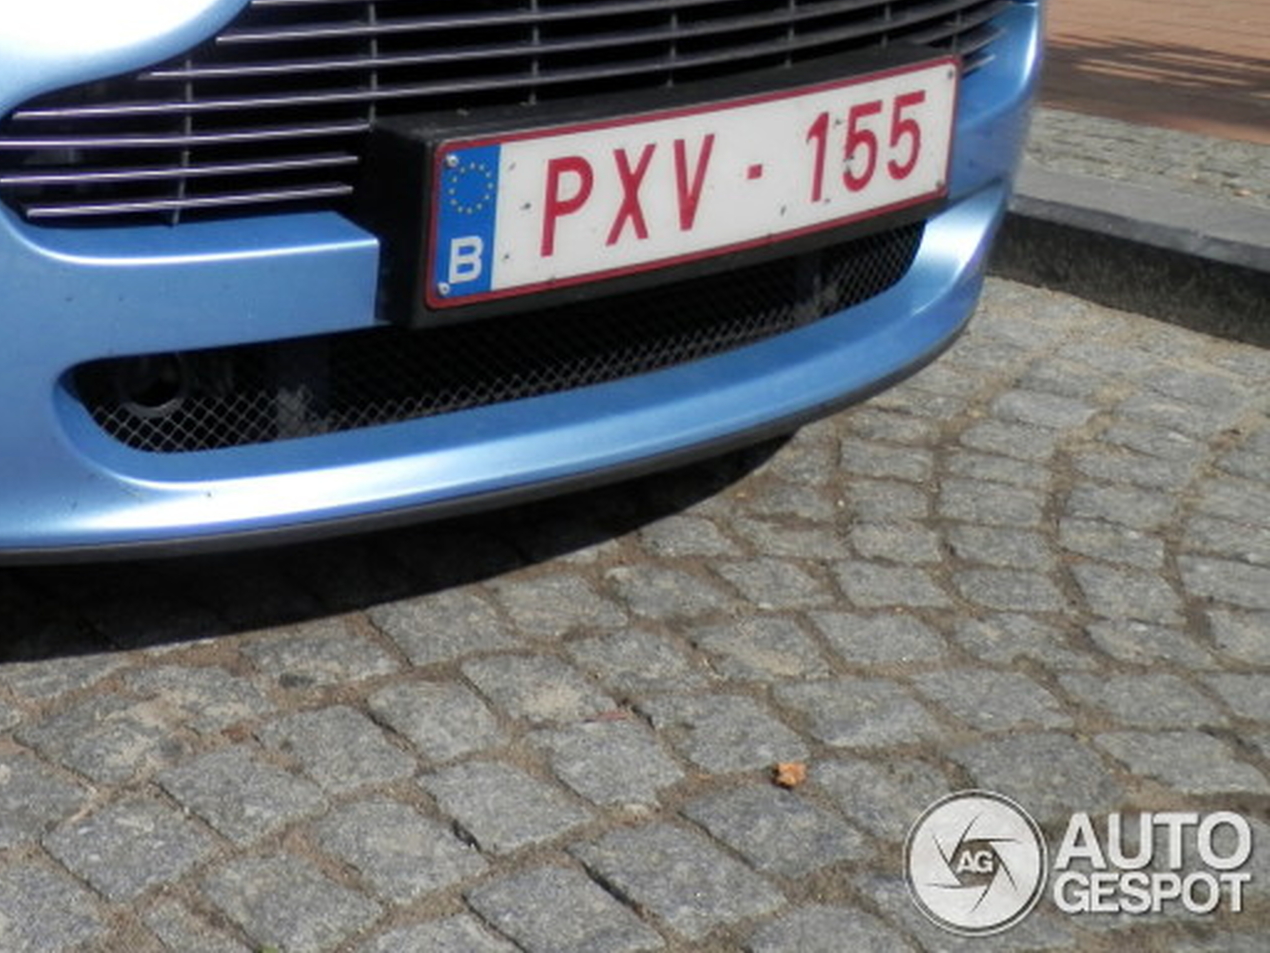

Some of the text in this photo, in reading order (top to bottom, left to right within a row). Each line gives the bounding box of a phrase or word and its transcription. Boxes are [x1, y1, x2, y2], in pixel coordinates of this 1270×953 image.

[540, 134, 715, 257] PXV
[804, 90, 926, 202] 155
[448, 236, 483, 285] B
